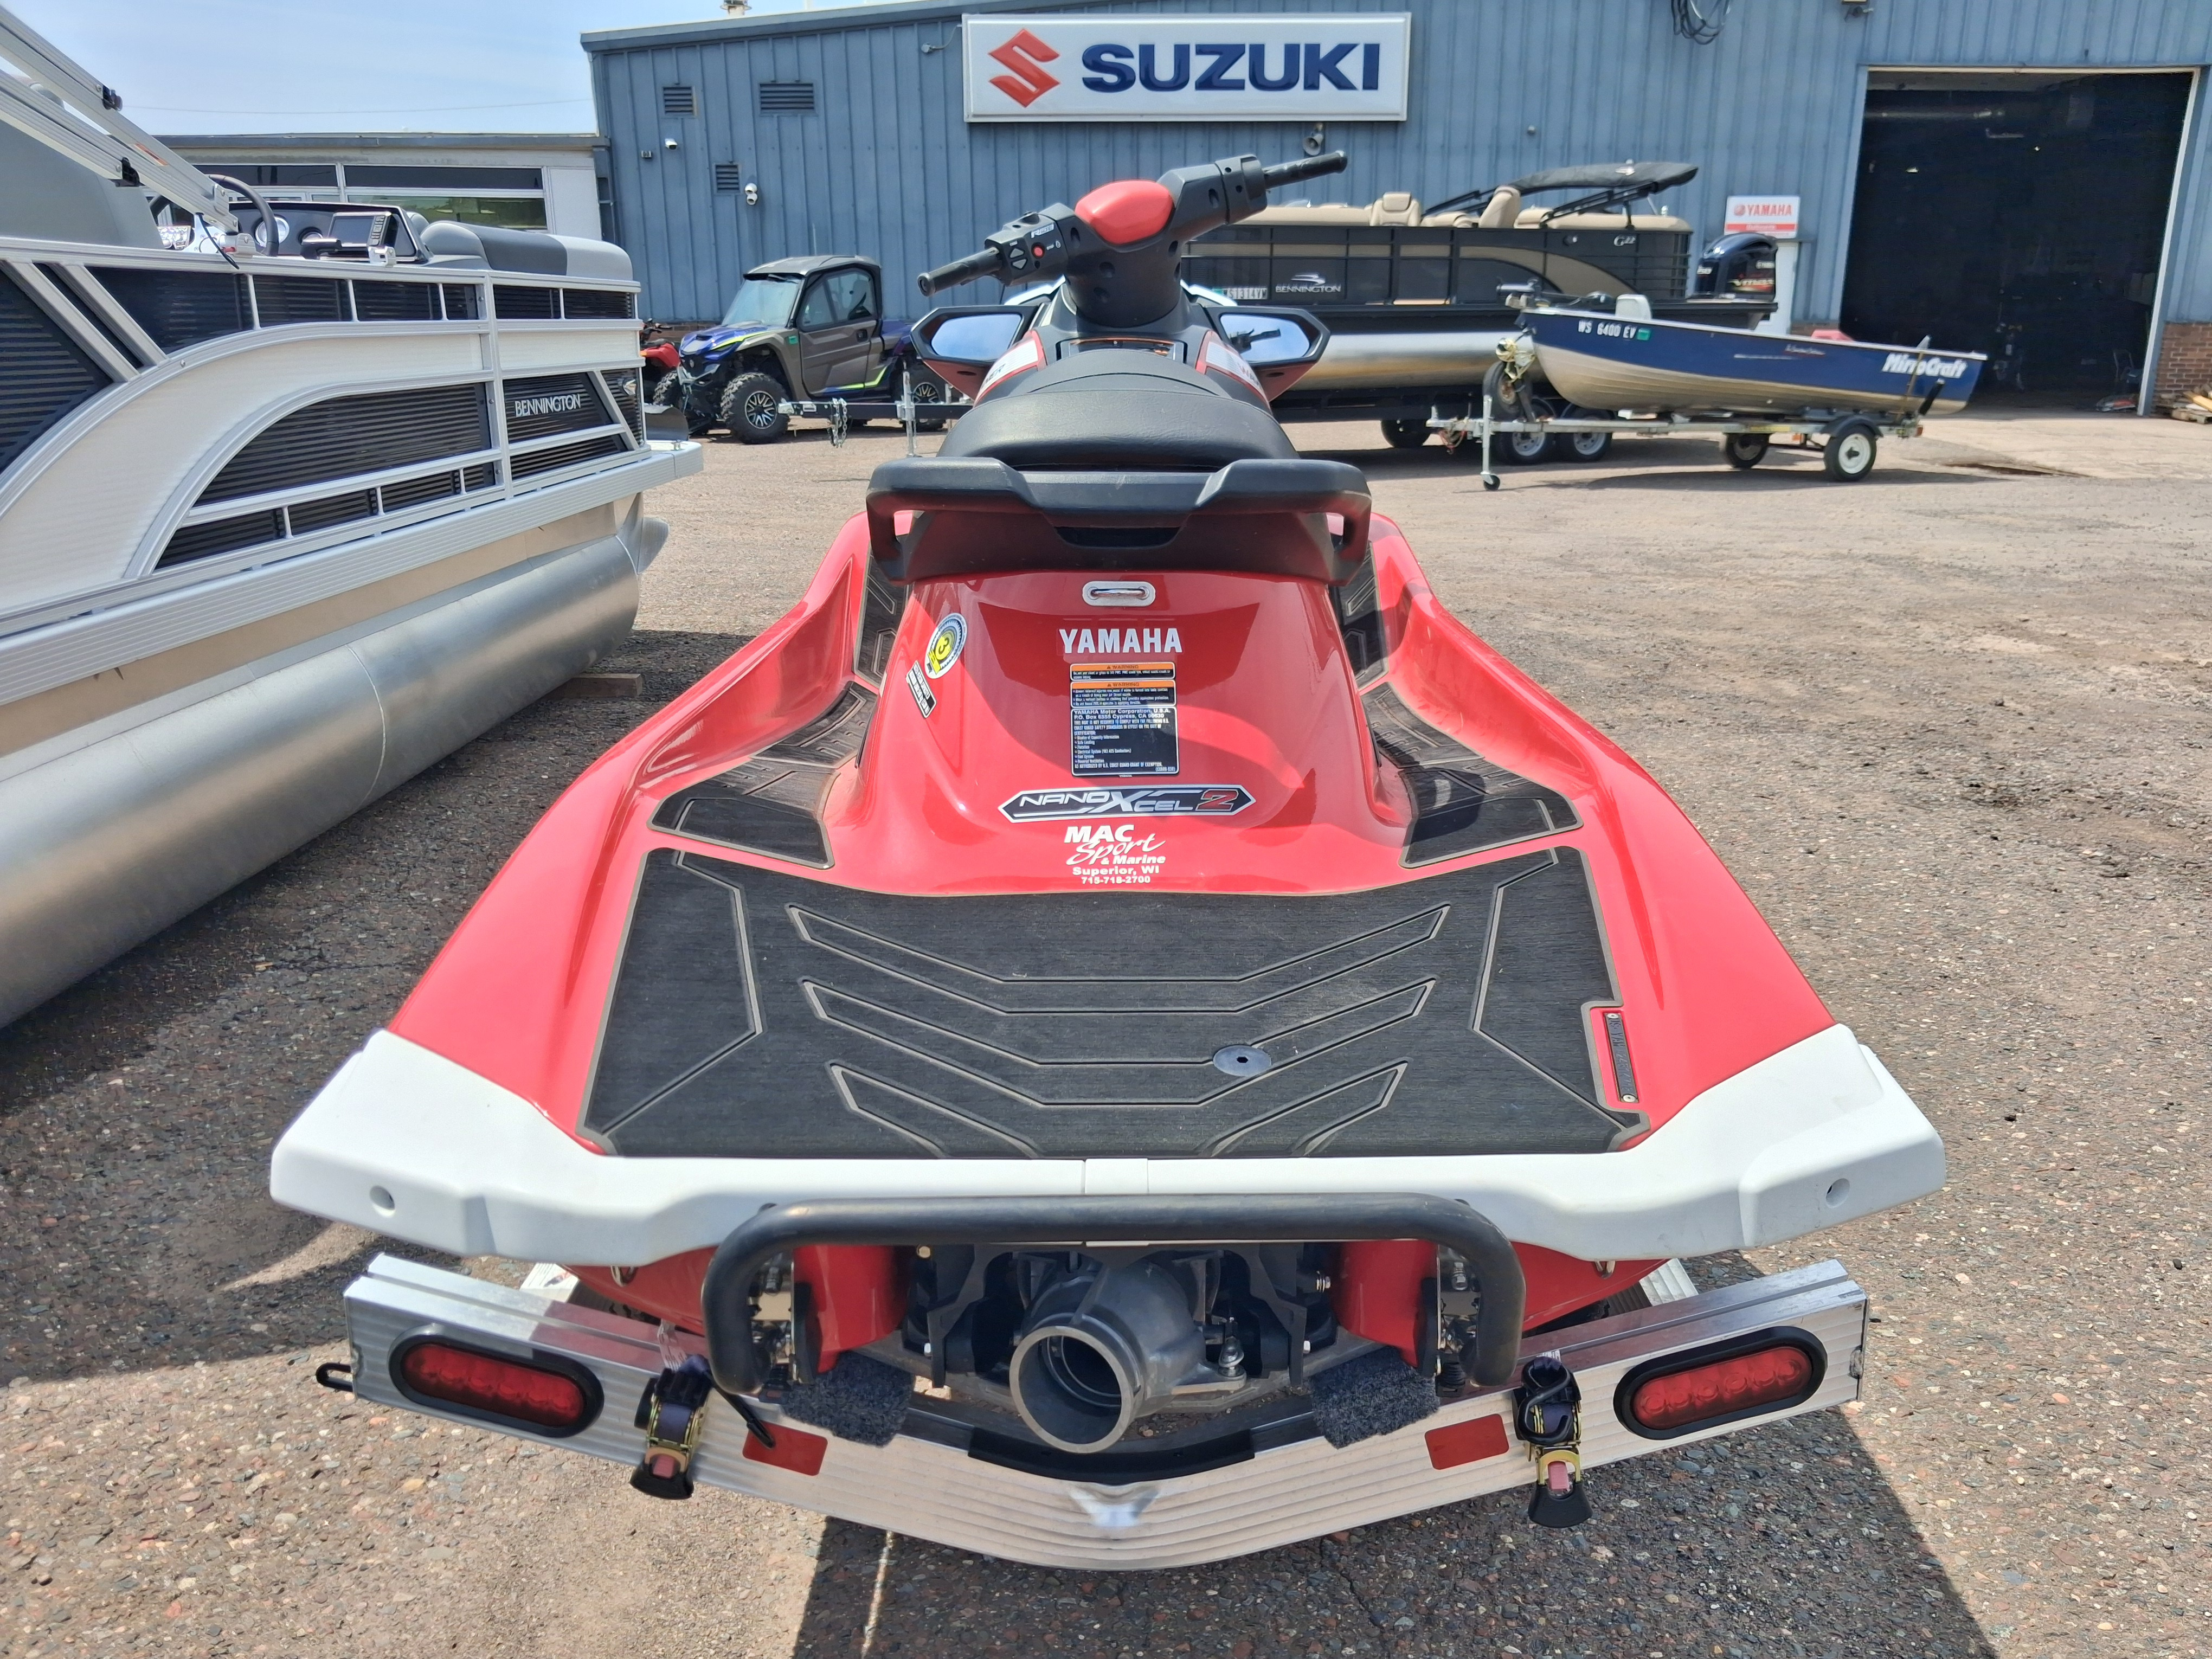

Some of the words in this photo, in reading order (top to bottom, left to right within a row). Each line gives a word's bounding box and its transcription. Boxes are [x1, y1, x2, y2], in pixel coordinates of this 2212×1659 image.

[1082, 43, 1380, 93] SUZUKI
[1747, 204, 1792, 216] YAMAHA
[1578, 319, 1593, 333] WS
[1597, 323, 1622, 337] 6400
[1623, 326, 1637, 339] EV
[1882, 351, 1968, 379] MirroCraft
[515, 393, 581, 417] BENNINGTON
[1059, 628, 1183, 654] YAMAHA
[1064, 825, 1134, 843] MAC
[1065, 833, 1166, 865] Sport
[1101, 857, 1109, 865] &
[1113, 854, 1166, 864] Marine
[1072, 866, 1137, 876] Superior,
[1141, 866, 1159, 874] WI
[1081, 876, 1151, 884] 715-718-2700
